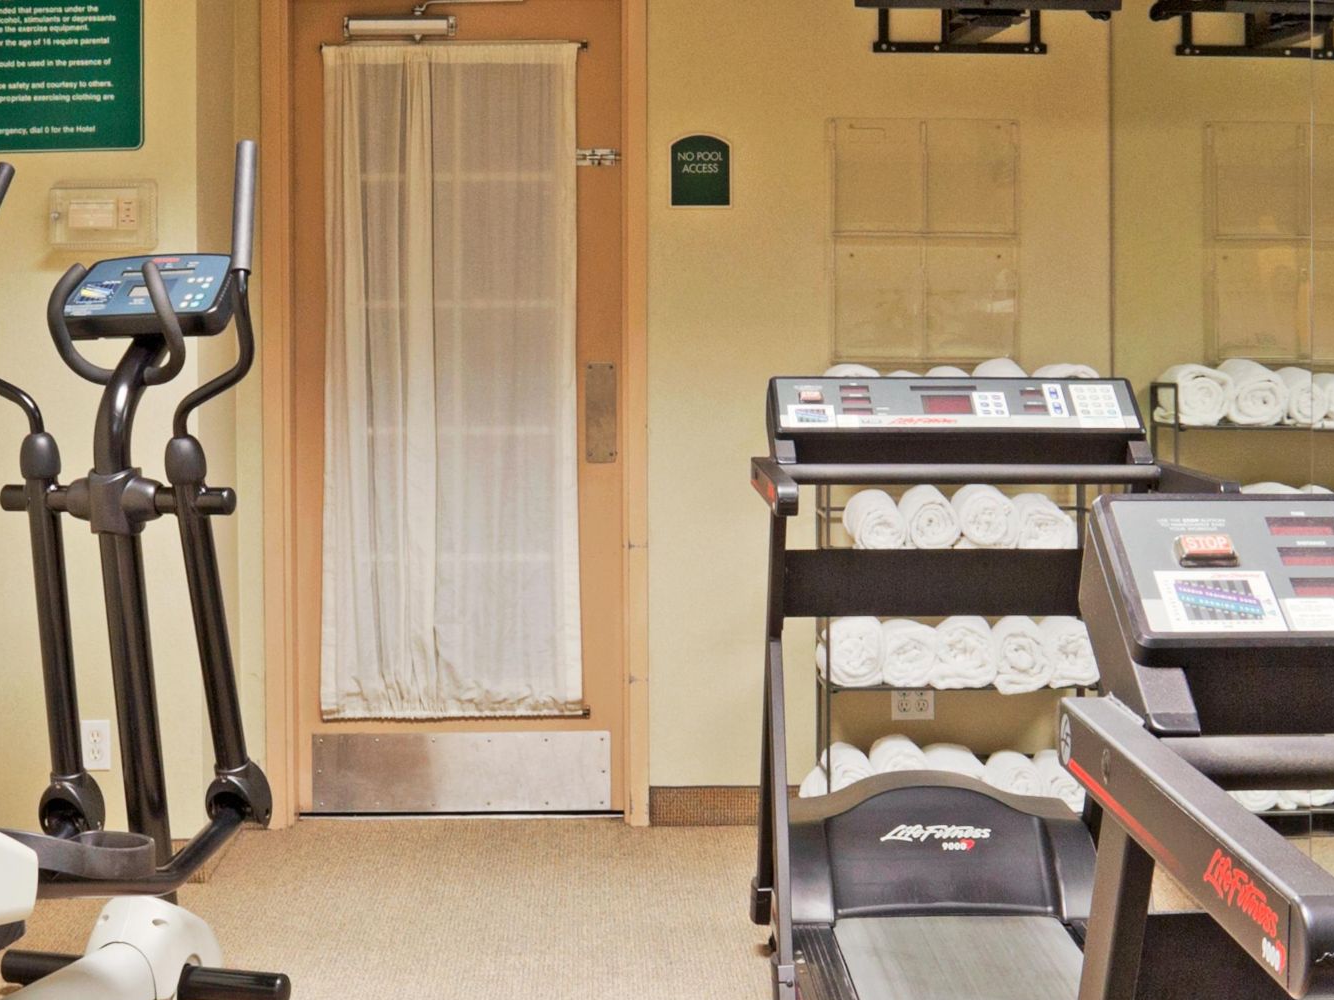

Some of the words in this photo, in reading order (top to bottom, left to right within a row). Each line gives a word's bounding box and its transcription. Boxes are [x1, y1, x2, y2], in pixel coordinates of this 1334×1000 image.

[677, 152, 694, 161] NO
[696, 152, 723, 161] POOL
[682, 163, 719, 173] ACCESS
[1186, 535, 1228, 549] STOP
